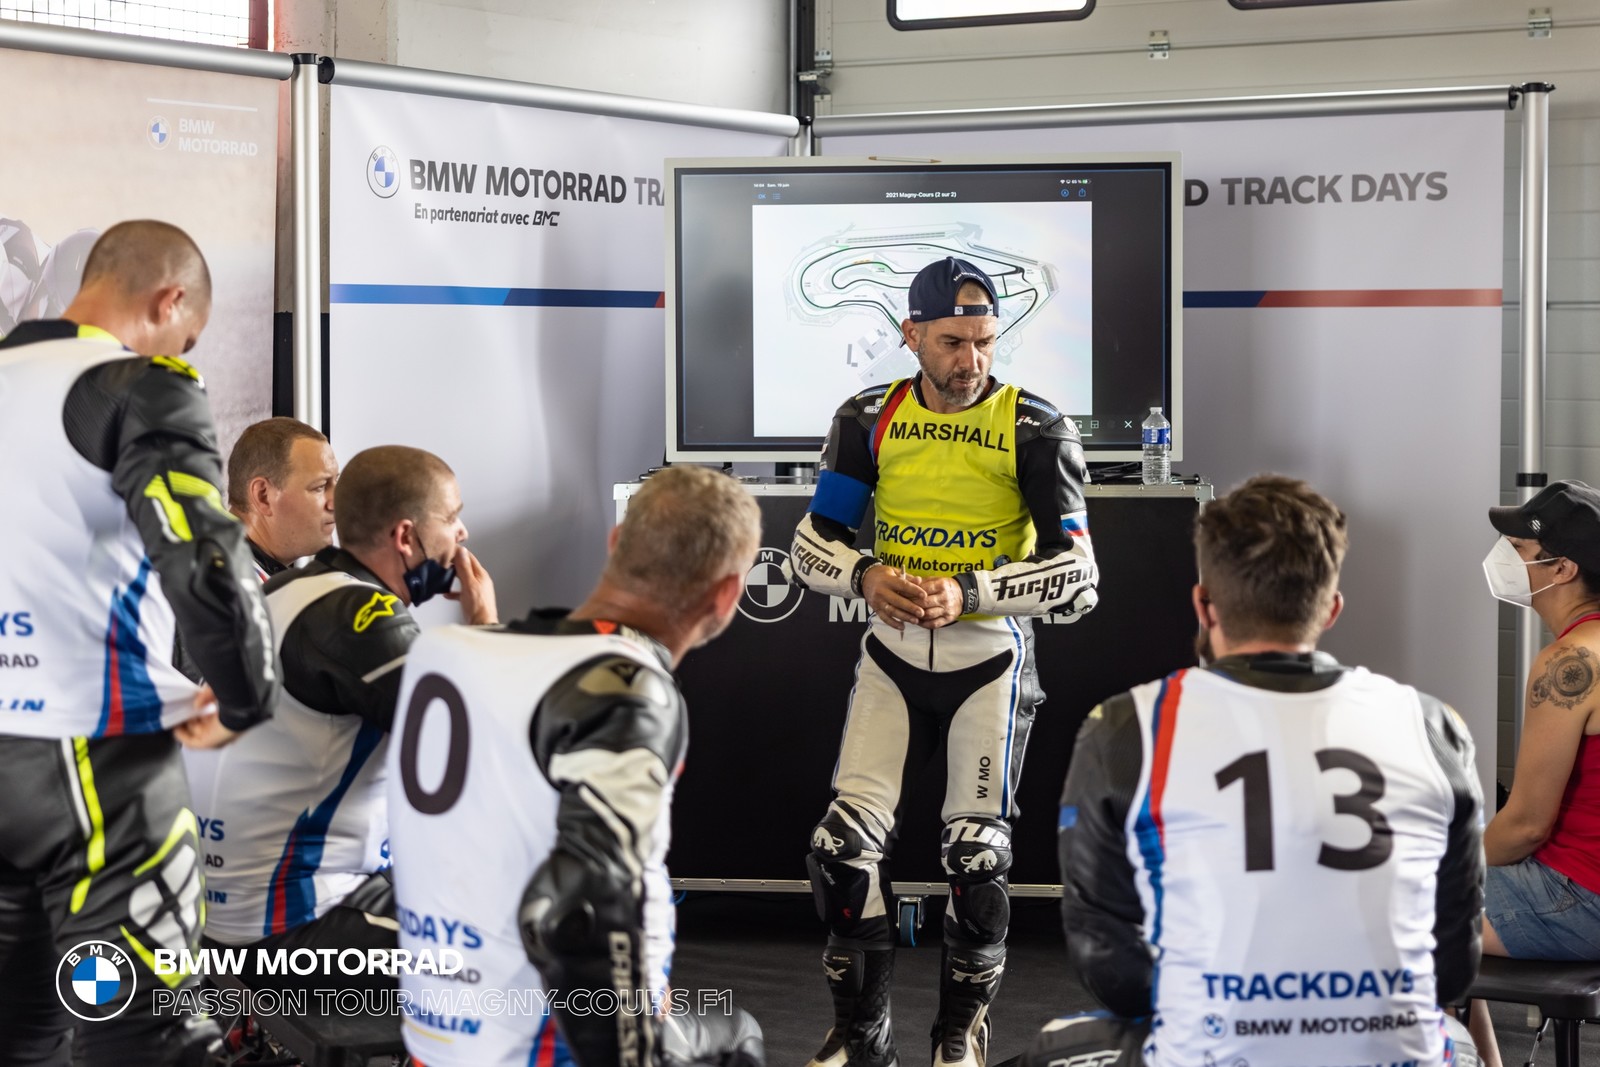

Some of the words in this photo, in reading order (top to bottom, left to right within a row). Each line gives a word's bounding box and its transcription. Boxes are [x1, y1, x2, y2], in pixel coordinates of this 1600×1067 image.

[180, 119, 215, 134] BMW
[179, 137, 258, 156] MOTORRAD
[409, 159, 477, 194] BMW
[485, 165, 627, 204] MOTORRAD
[634, 176, 665, 206] TR
[1220, 175, 1343, 205] TRACK
[1351, 171, 1448, 203] DAYS
[414, 203, 428, 219] En
[430, 206, 498, 224] partenariat
[501, 211, 529, 226] avec
[889, 421, 1010, 453] MARSHALL
[876, 520, 998, 548] TRACKDAYS
[880, 552, 906, 568] BMW
[908, 557, 984, 573] Motorrad
[400, 672, 471, 815] 0
[1214, 747, 1394, 872] 13
[1202, 969, 1415, 1001] TRACKDAYS
[1235, 1019, 1292, 1036] BMW
[1300, 1011, 1419, 1035] MOTORRAD
